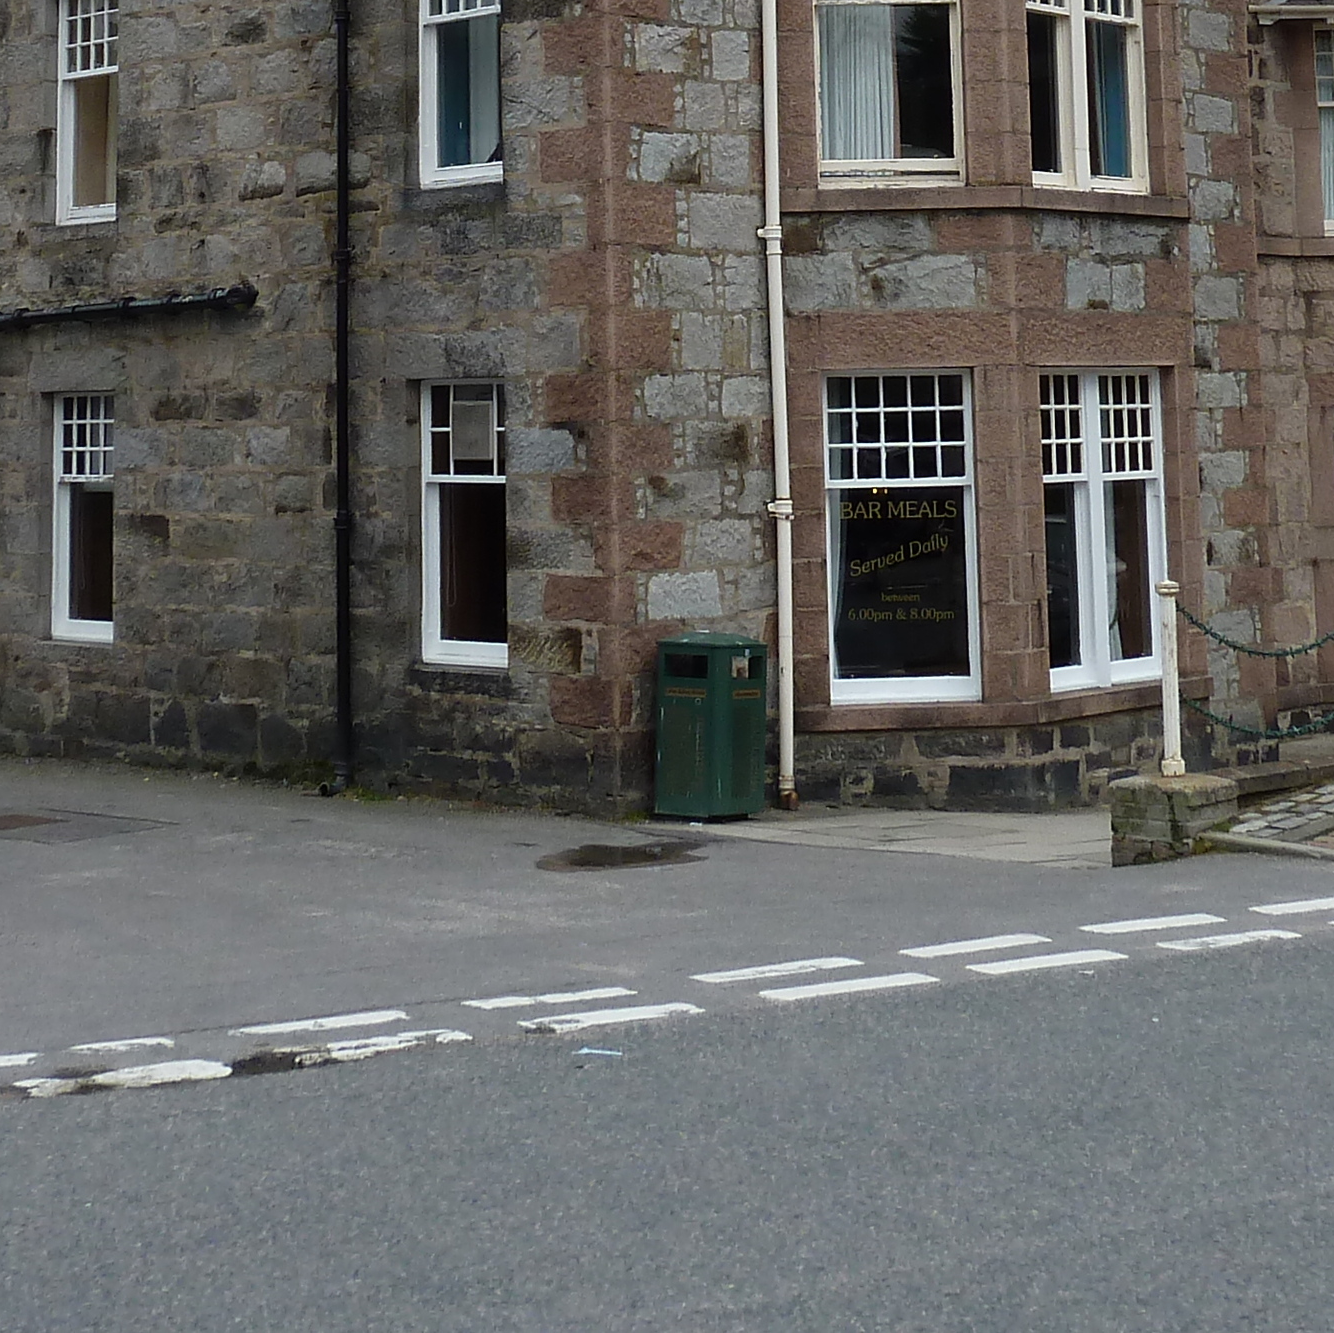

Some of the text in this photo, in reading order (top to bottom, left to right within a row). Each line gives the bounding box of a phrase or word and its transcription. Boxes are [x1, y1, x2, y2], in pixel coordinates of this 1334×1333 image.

[840, 500, 957, 519] BAR MEALS
[850, 532, 949, 577] Served Daily
[881, 592, 921, 602] between
[896, 608, 906, 620] &
